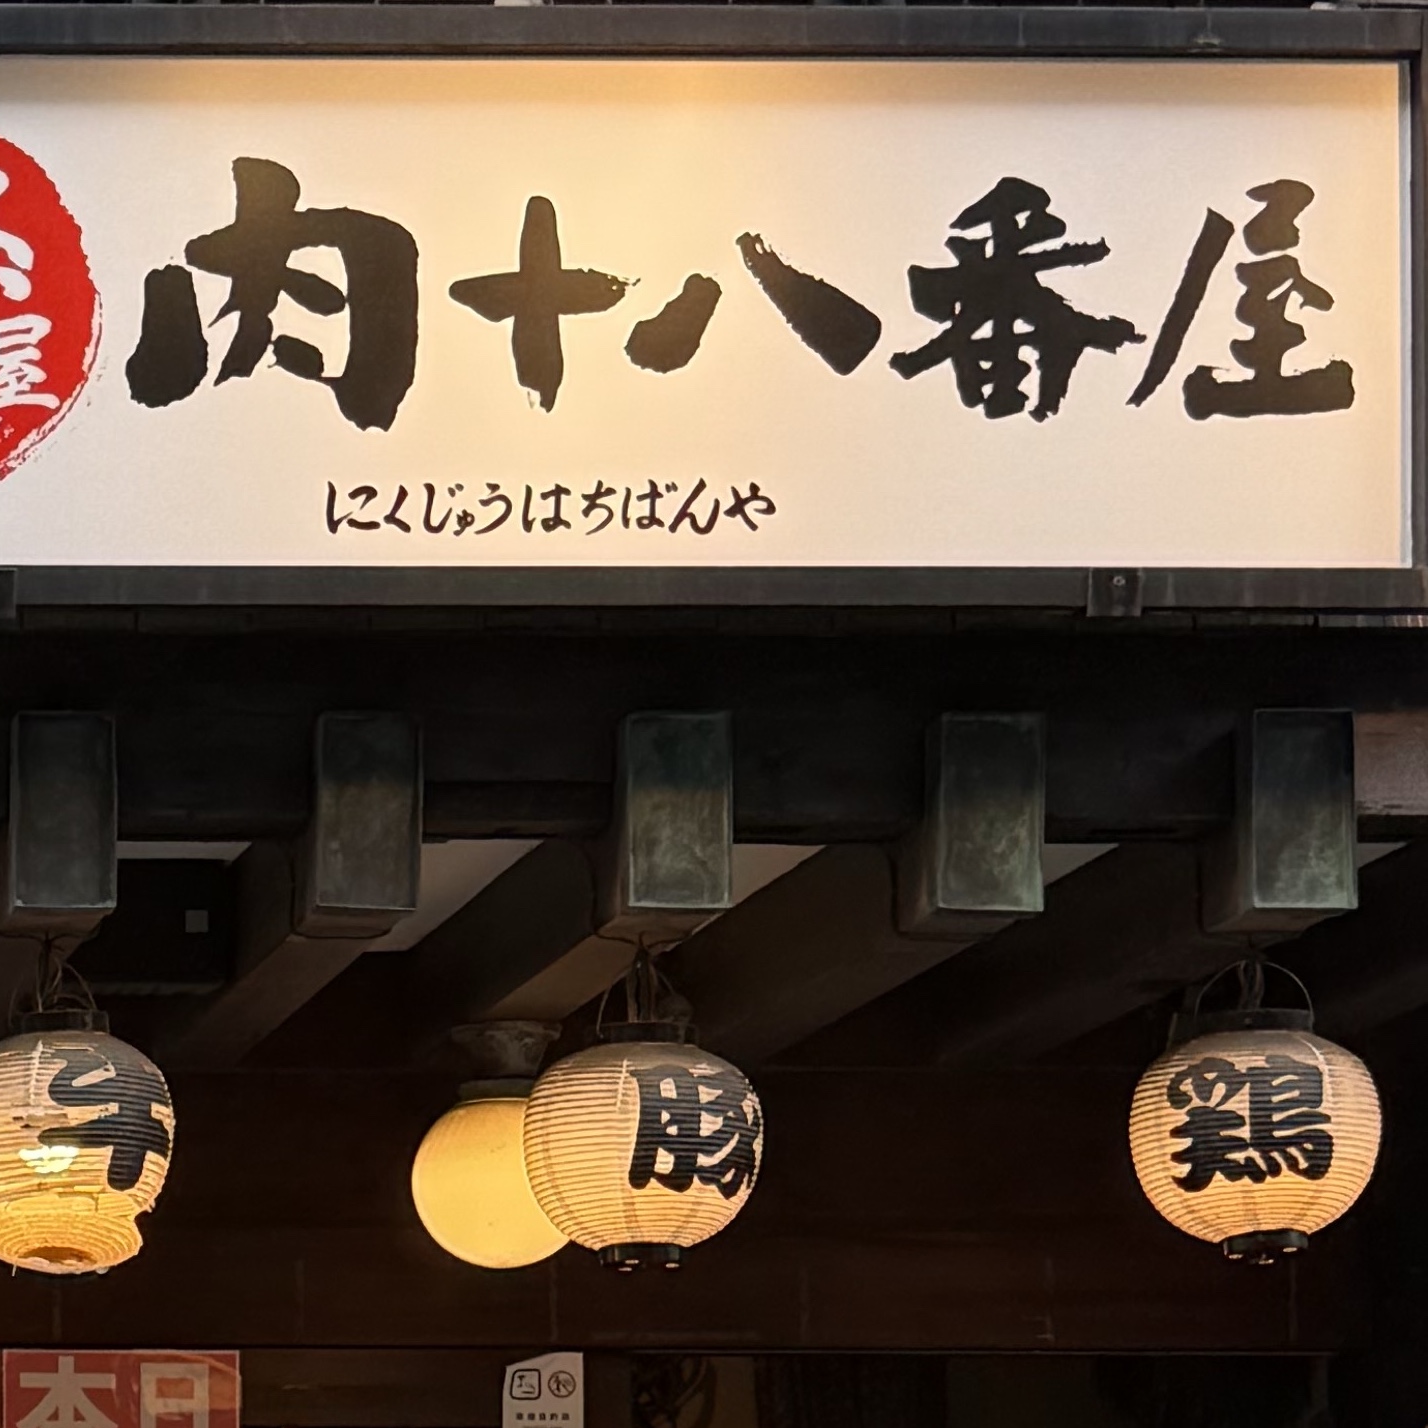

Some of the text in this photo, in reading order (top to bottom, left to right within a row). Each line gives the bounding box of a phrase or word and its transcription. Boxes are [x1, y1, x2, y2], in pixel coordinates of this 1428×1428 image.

[124, 156, 1356, 432] 肉十八番屋
[323, 477, 778, 539] にくじゅうはちばんや
